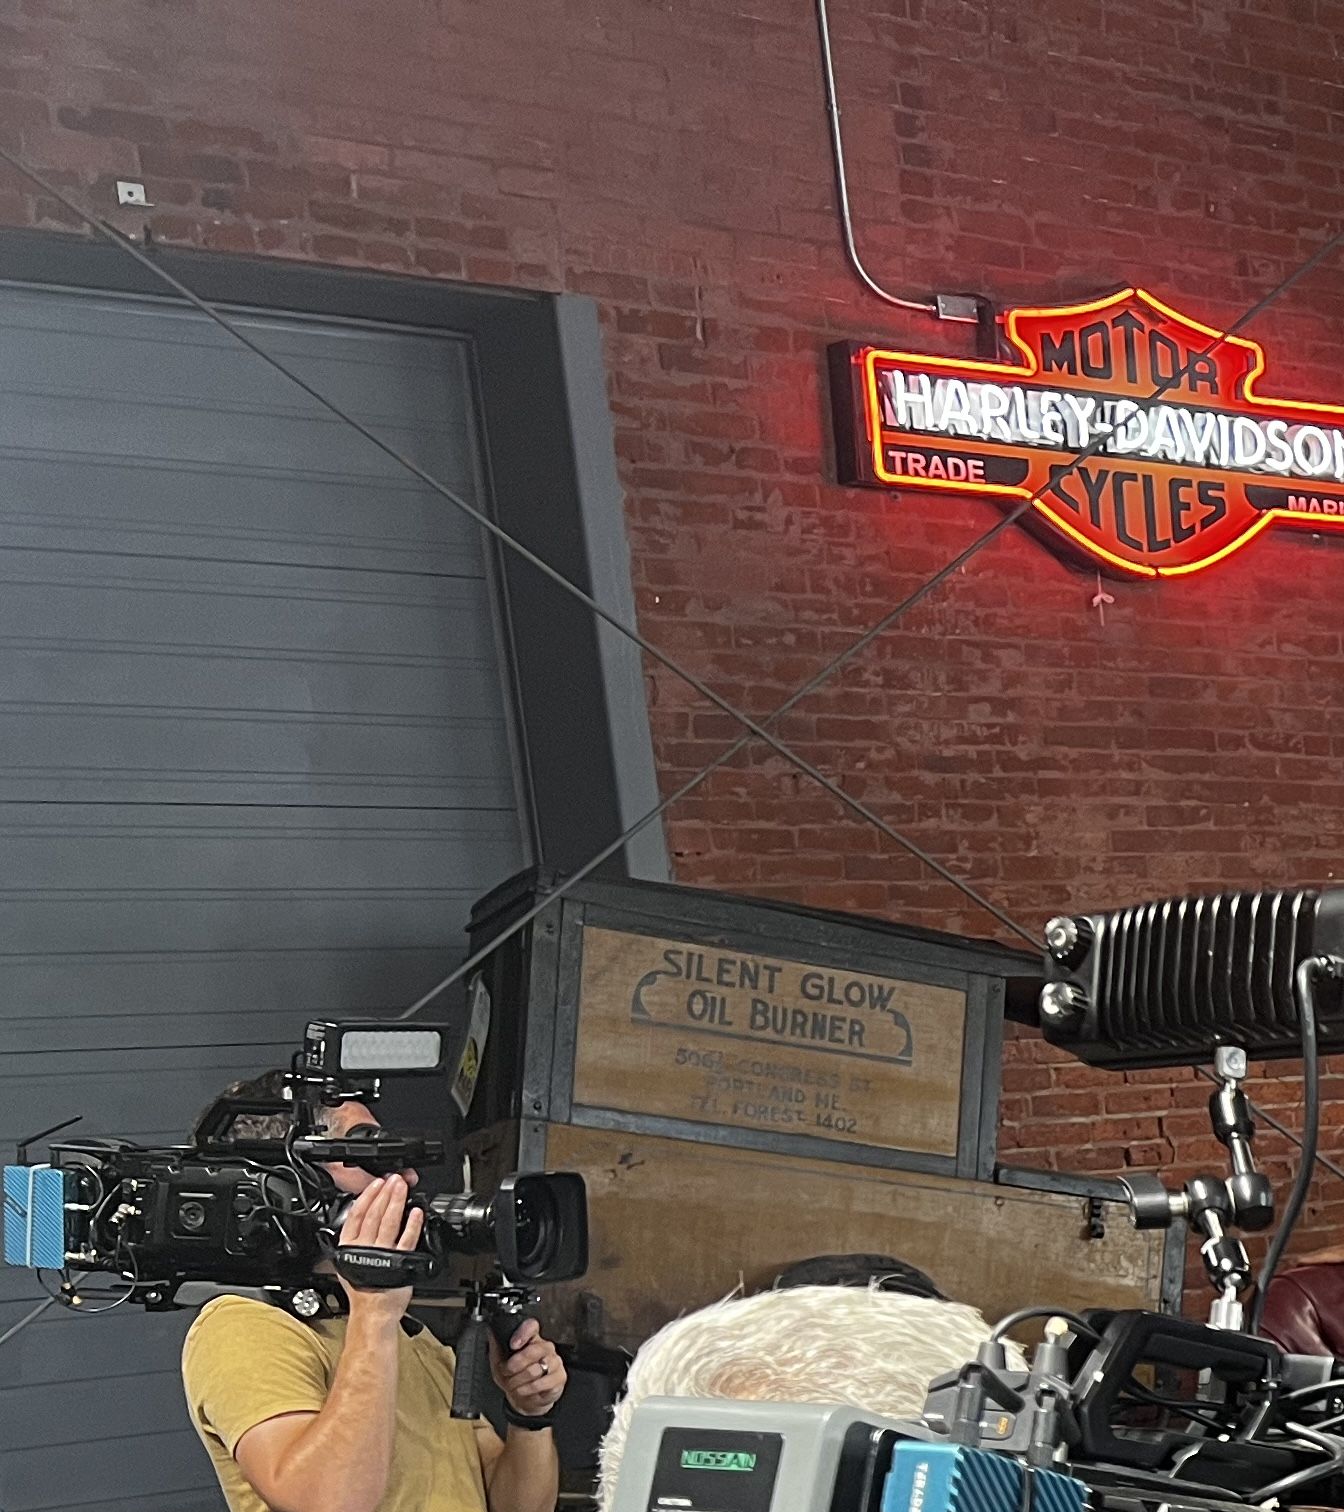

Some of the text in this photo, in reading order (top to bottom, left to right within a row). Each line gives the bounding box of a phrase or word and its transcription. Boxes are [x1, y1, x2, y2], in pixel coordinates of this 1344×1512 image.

[1038, 310, 1219, 396] MOTOR
[887, 452, 985, 484] TRADE
[1046, 465, 1227, 553] CYCLES
[662, 948, 895, 1012] SILENT GLOW
[686, 988, 866, 1048] OIL BURNER
[815, 1112, 859, 1134] 1402
[344, 1253, 391, 1268] FUJINON
